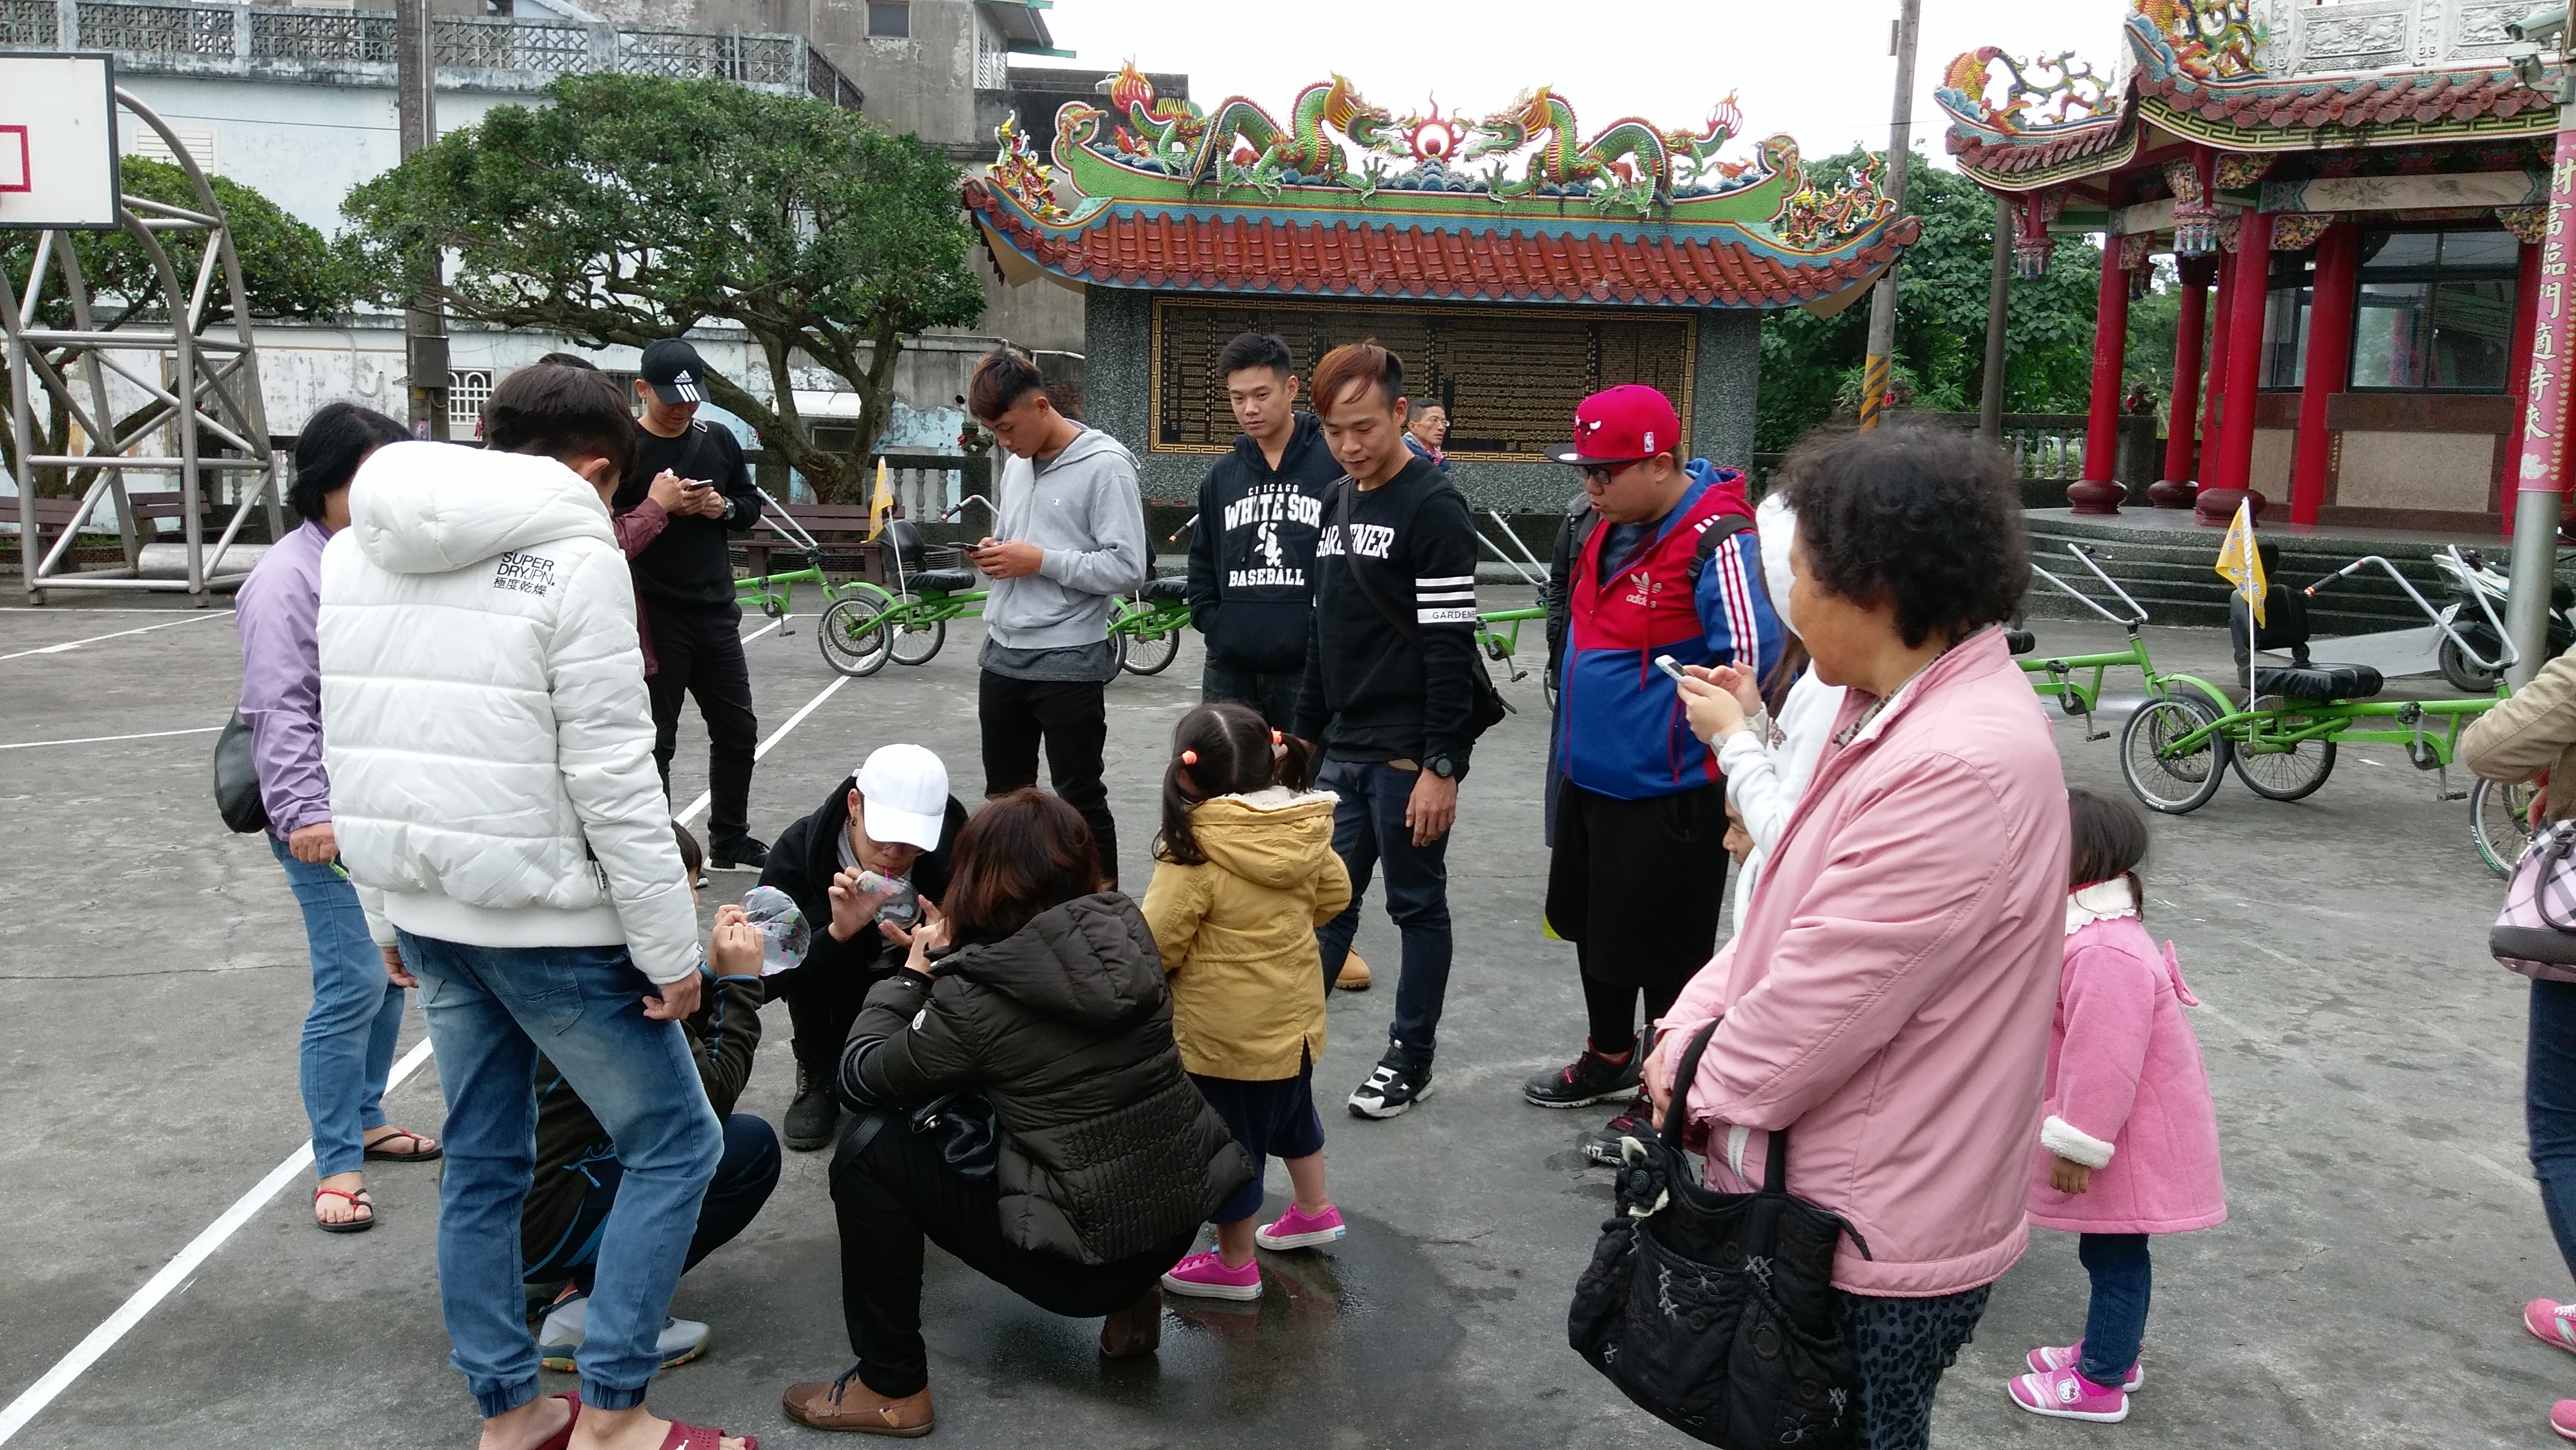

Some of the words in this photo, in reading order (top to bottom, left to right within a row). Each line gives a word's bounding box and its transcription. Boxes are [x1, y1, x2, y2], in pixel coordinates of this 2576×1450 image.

[1224, 494, 1284, 532] WHITE
[1287, 494, 1321, 528] SOX
[502, 552, 554, 571] SUPER
[493, 576, 547, 597] 極度乾燥
[1229, 568, 1305, 587] BASEBALL
[1626, 594, 1657, 608] adids
